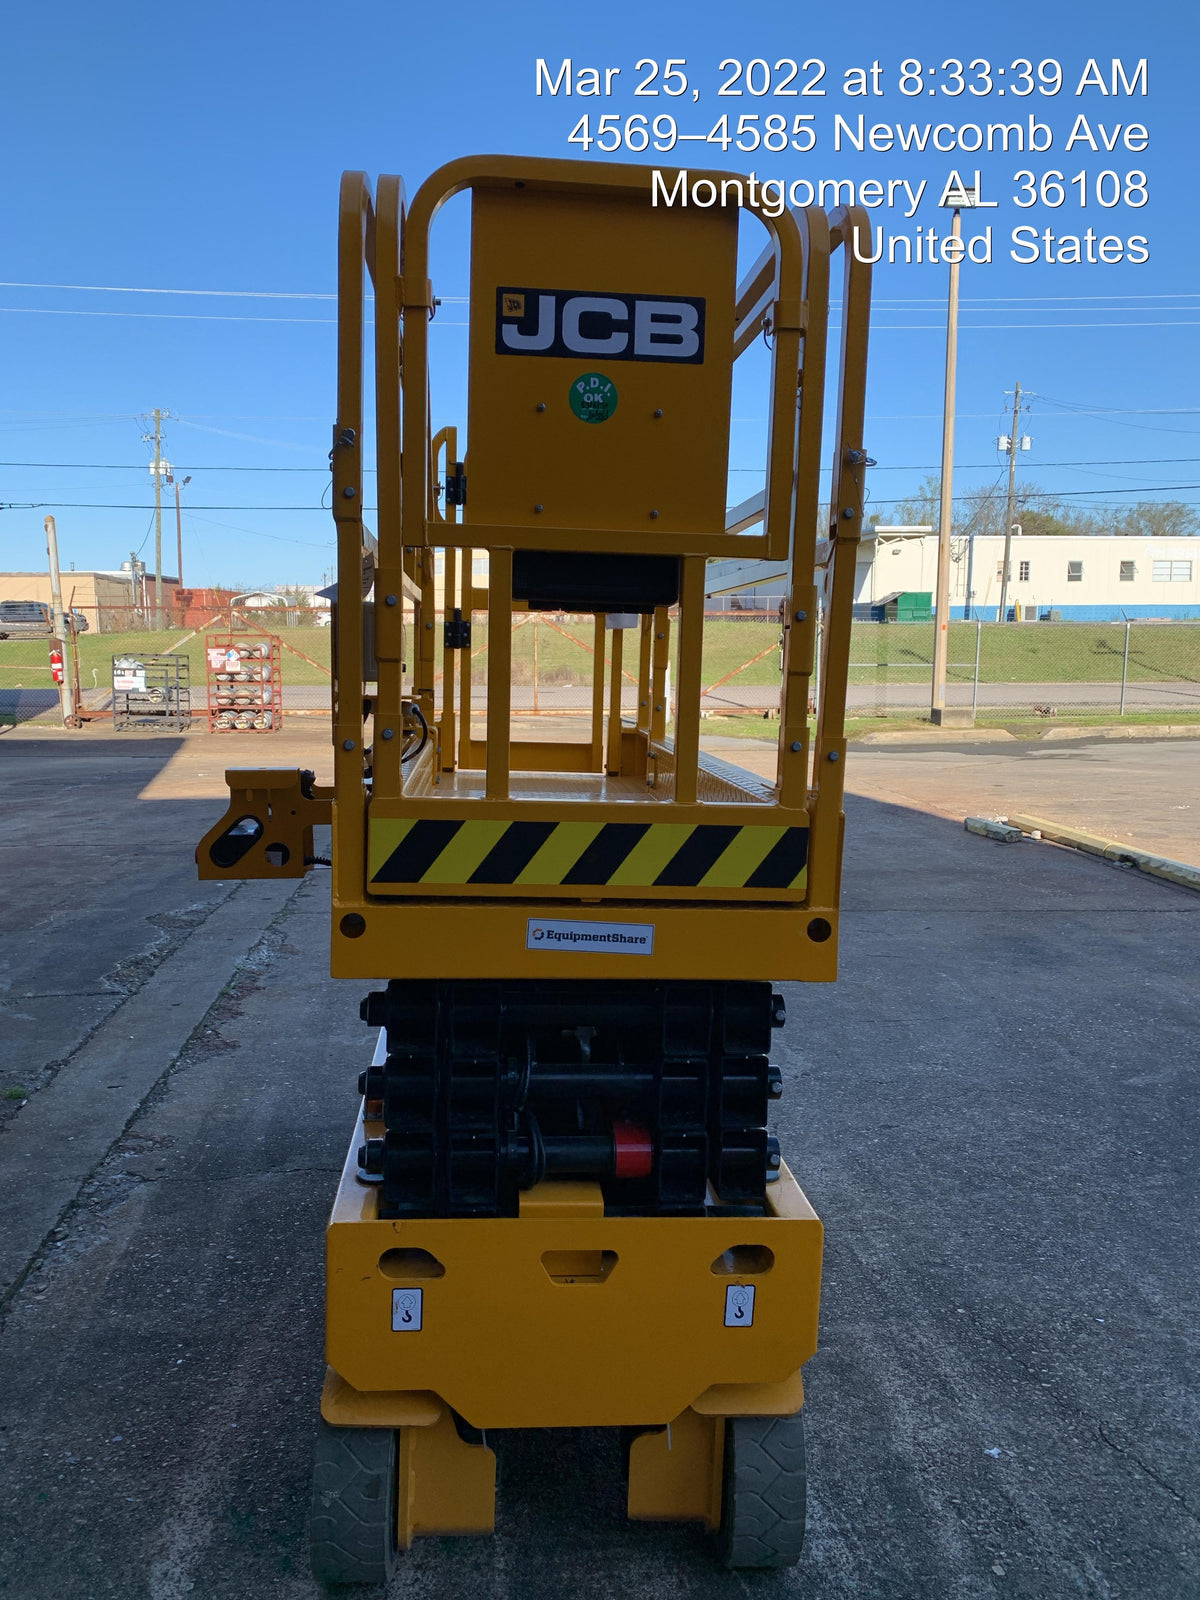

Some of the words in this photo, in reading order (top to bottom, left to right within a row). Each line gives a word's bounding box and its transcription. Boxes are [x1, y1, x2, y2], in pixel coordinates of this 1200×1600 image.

[502, 295, 700, 358] JCB
[584, 393, 603, 403] OK
[546, 929, 648, 945] EquipmentShare
